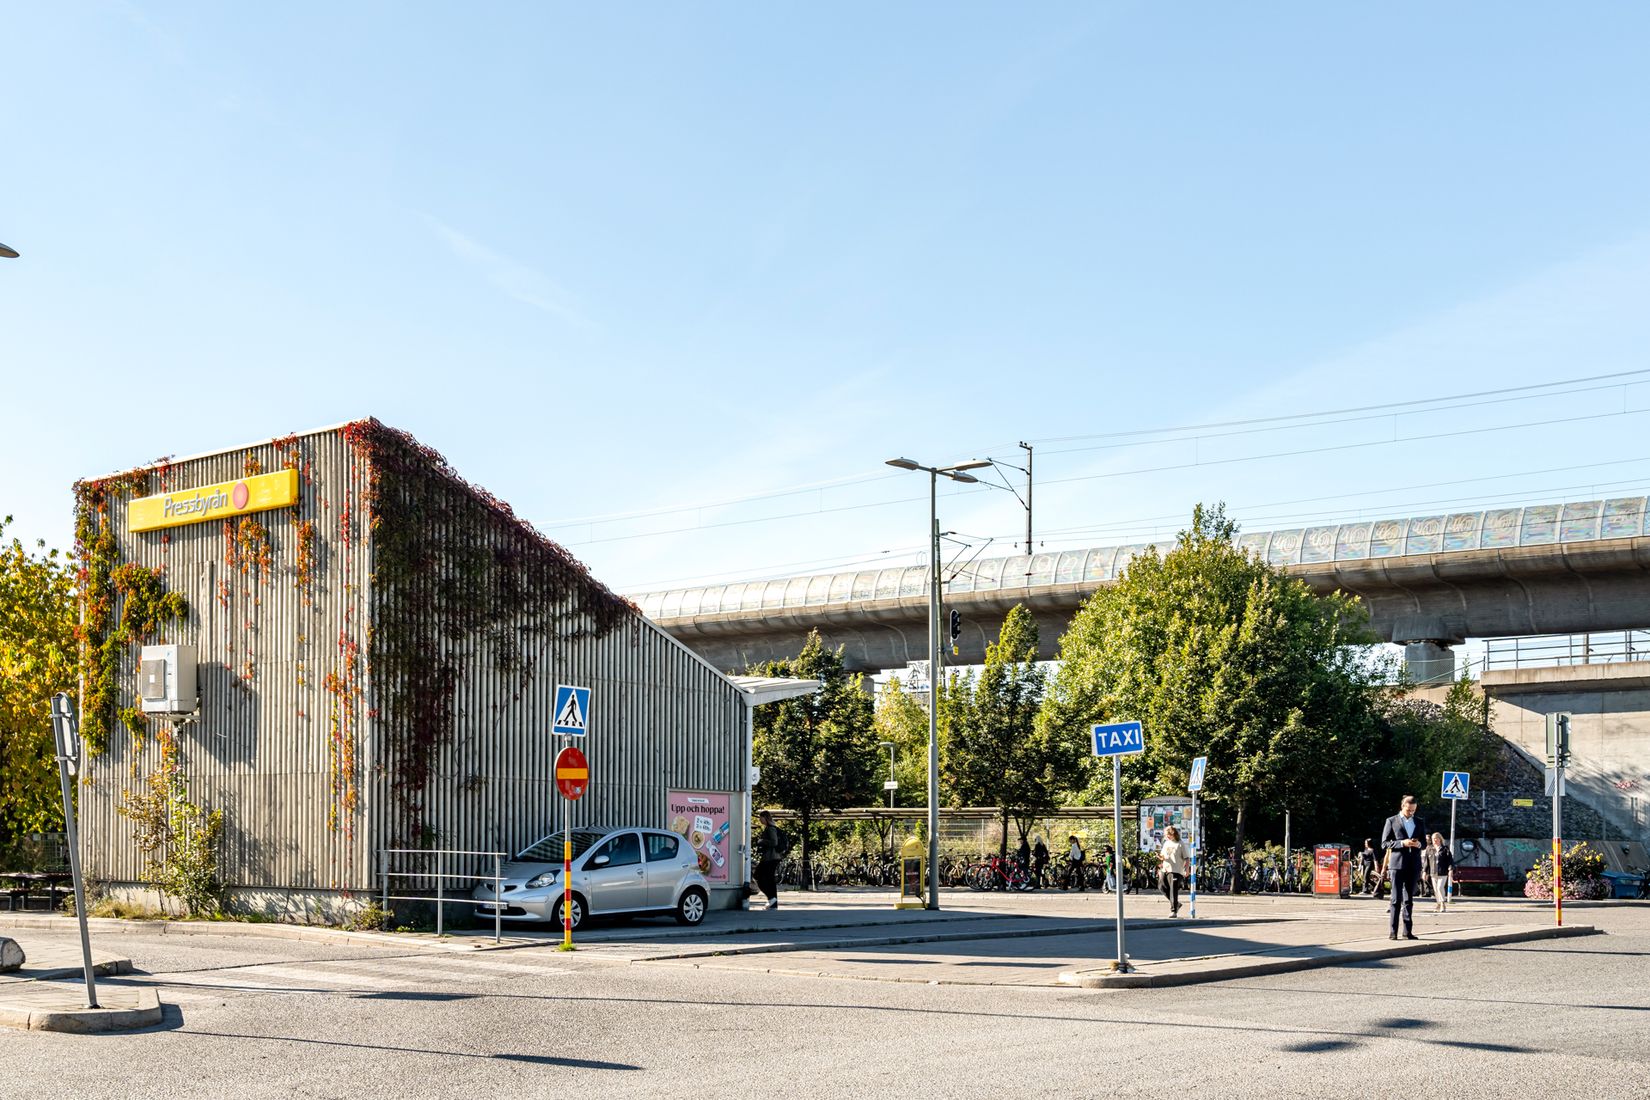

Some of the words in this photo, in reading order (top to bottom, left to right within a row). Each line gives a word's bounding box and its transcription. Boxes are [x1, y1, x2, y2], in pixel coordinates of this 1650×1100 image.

[163, 490, 228, 517] Pressbyrån
[1098, 729, 1140, 748] TAXI
[671, 804, 685, 814] Upp
[687, 805, 700, 813] och
[700, 805, 725, 815] hoppa!
